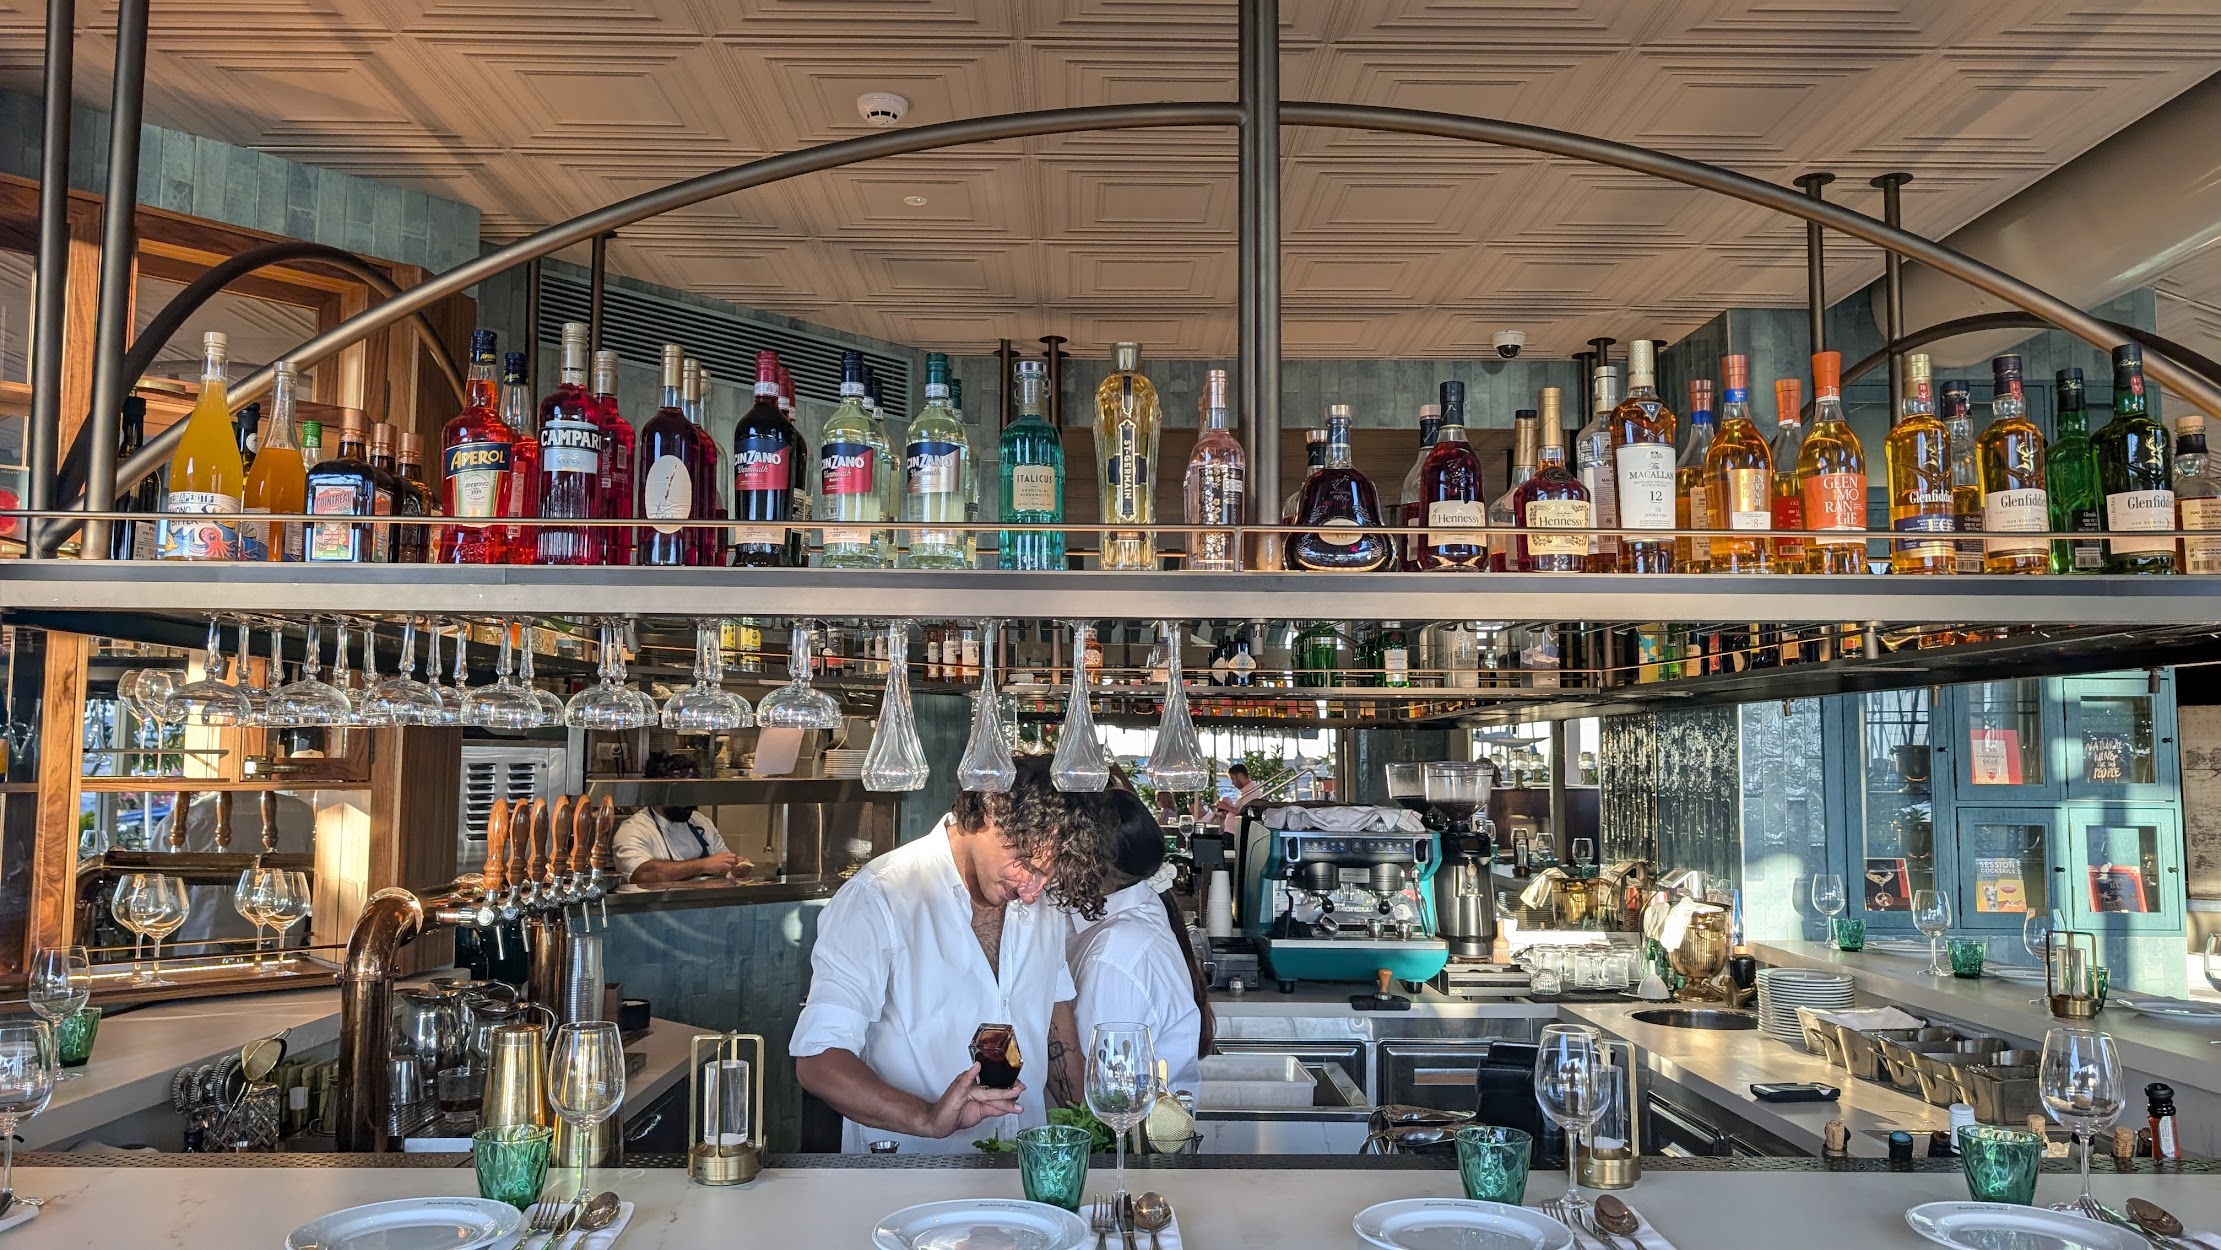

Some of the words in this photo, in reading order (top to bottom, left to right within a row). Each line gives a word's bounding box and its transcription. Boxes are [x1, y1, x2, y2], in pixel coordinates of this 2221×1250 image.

[540, 430, 602, 451] CAMPARI
[450, 450, 506, 471] APEROL
[1123, 439, 1133, 499] ST-GERMAIN
[1629, 471, 1675, 480] MACALLAN
[1017, 474, 1052, 484] ITALICUS
[1823, 476, 1859, 490] GLEN
[318, 491, 352, 508] COINTREAU
[1649, 490, 1663, 502] 12
[2000, 493, 2047, 508] Glenfiddic
[2127, 494, 2174, 510] Glenfiddic
[1824, 500, 1853, 513] RAN
[1438, 513, 1479, 526] Hennessy
[1539, 517, 1584, 527] Hennessy
[2094, 767, 2122, 779] PEOPLE
[1979, 861, 2015, 869] SESSION
